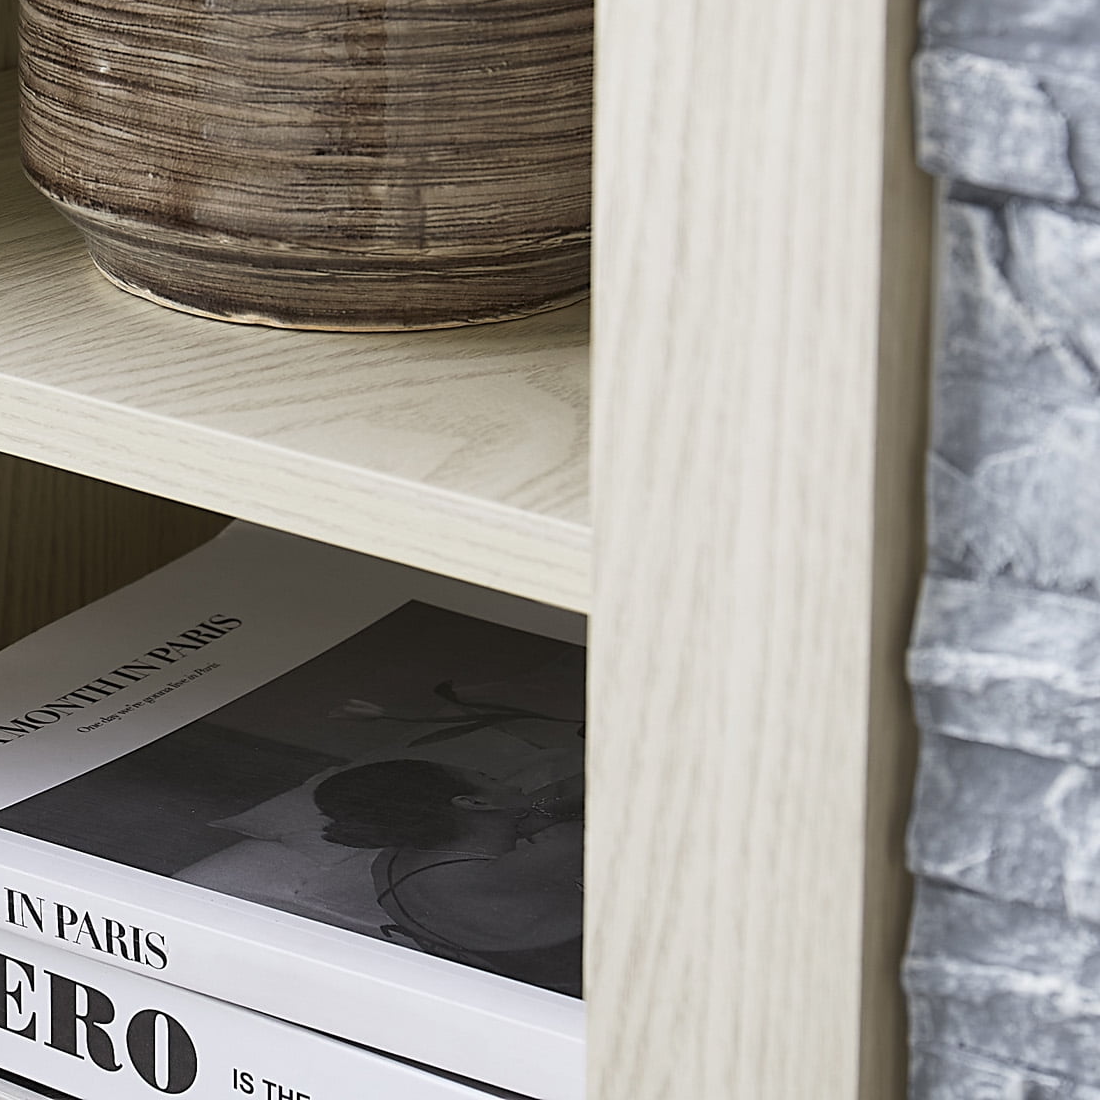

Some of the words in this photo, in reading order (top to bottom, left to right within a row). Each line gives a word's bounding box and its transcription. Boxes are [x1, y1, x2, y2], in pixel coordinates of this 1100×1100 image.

[109, 659, 161, 682] IN
[146, 614, 242, 664] PARIS
[77, 721, 101, 733] One
[4, 886, 44, 932] IN
[53, 902, 168, 969] PARIS
[233, 1067, 254, 1095] IS
